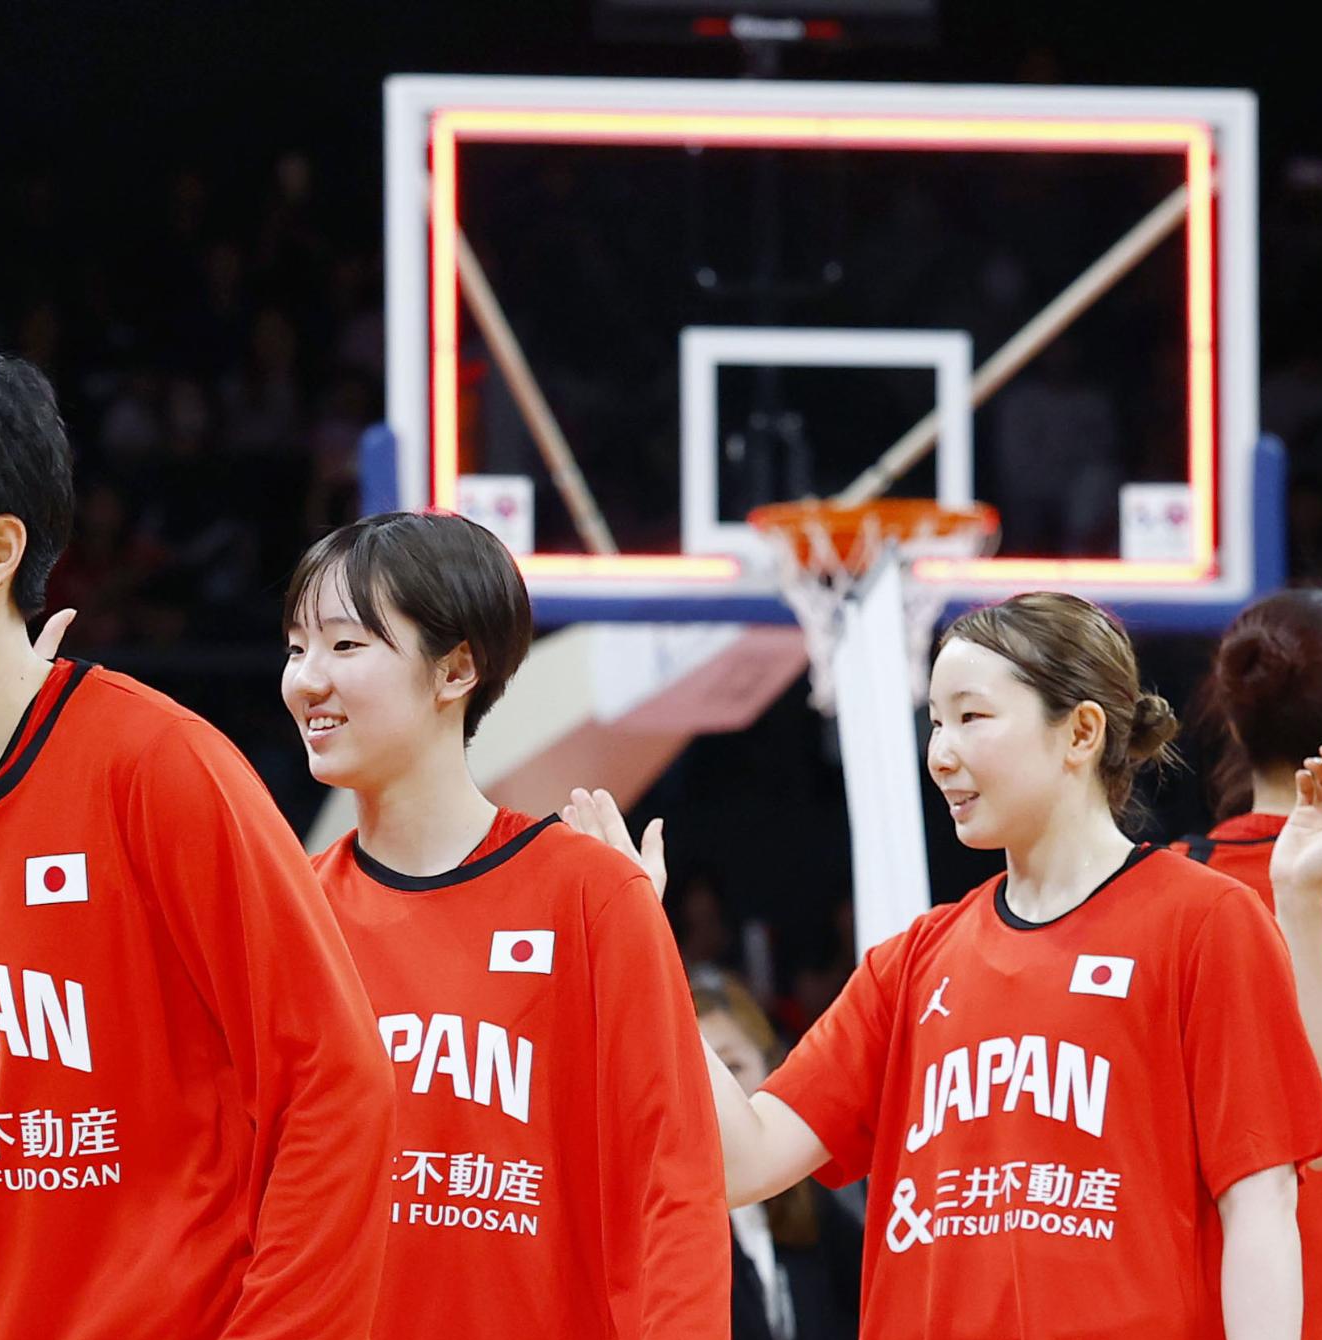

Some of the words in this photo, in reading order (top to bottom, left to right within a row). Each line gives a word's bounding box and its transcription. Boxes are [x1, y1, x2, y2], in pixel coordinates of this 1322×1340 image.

[378, 1013, 533, 1124] PAN
[905, 1035, 1110, 1153] JAPAN
[392, 1150, 544, 1206] 不動産
[935, 1161, 1121, 1212] 三井不動産
[409, 1203, 539, 1237] FUDOSAN
[1004, 1209, 1115, 1241] FUDOSAN
